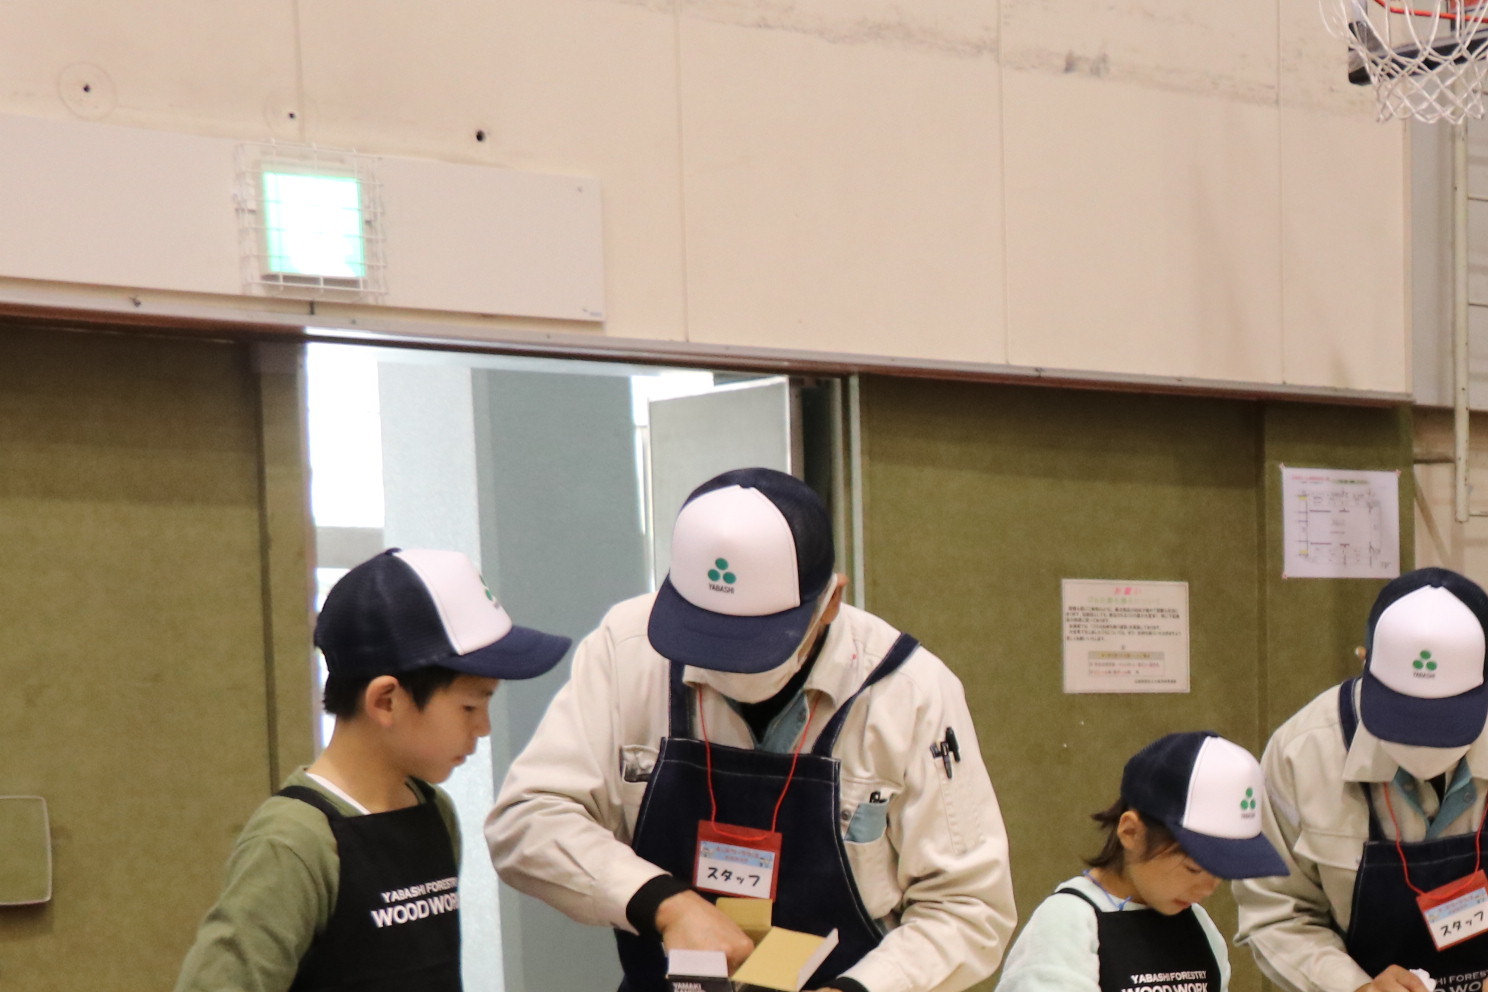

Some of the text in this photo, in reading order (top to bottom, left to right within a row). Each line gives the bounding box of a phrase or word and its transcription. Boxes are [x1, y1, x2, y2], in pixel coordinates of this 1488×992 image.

[708, 583, 735, 594] YABASHI
[707, 866, 760, 887] スタッフ
[381, 884, 427, 903] YABASHI
[370, 892, 459, 928] WOOD WOR
[1440, 910, 1484, 936] スタッフ
[673, 982, 702, 990] YAMAKI
[1130, 970, 1207, 985] YABASHI FORESTRY
